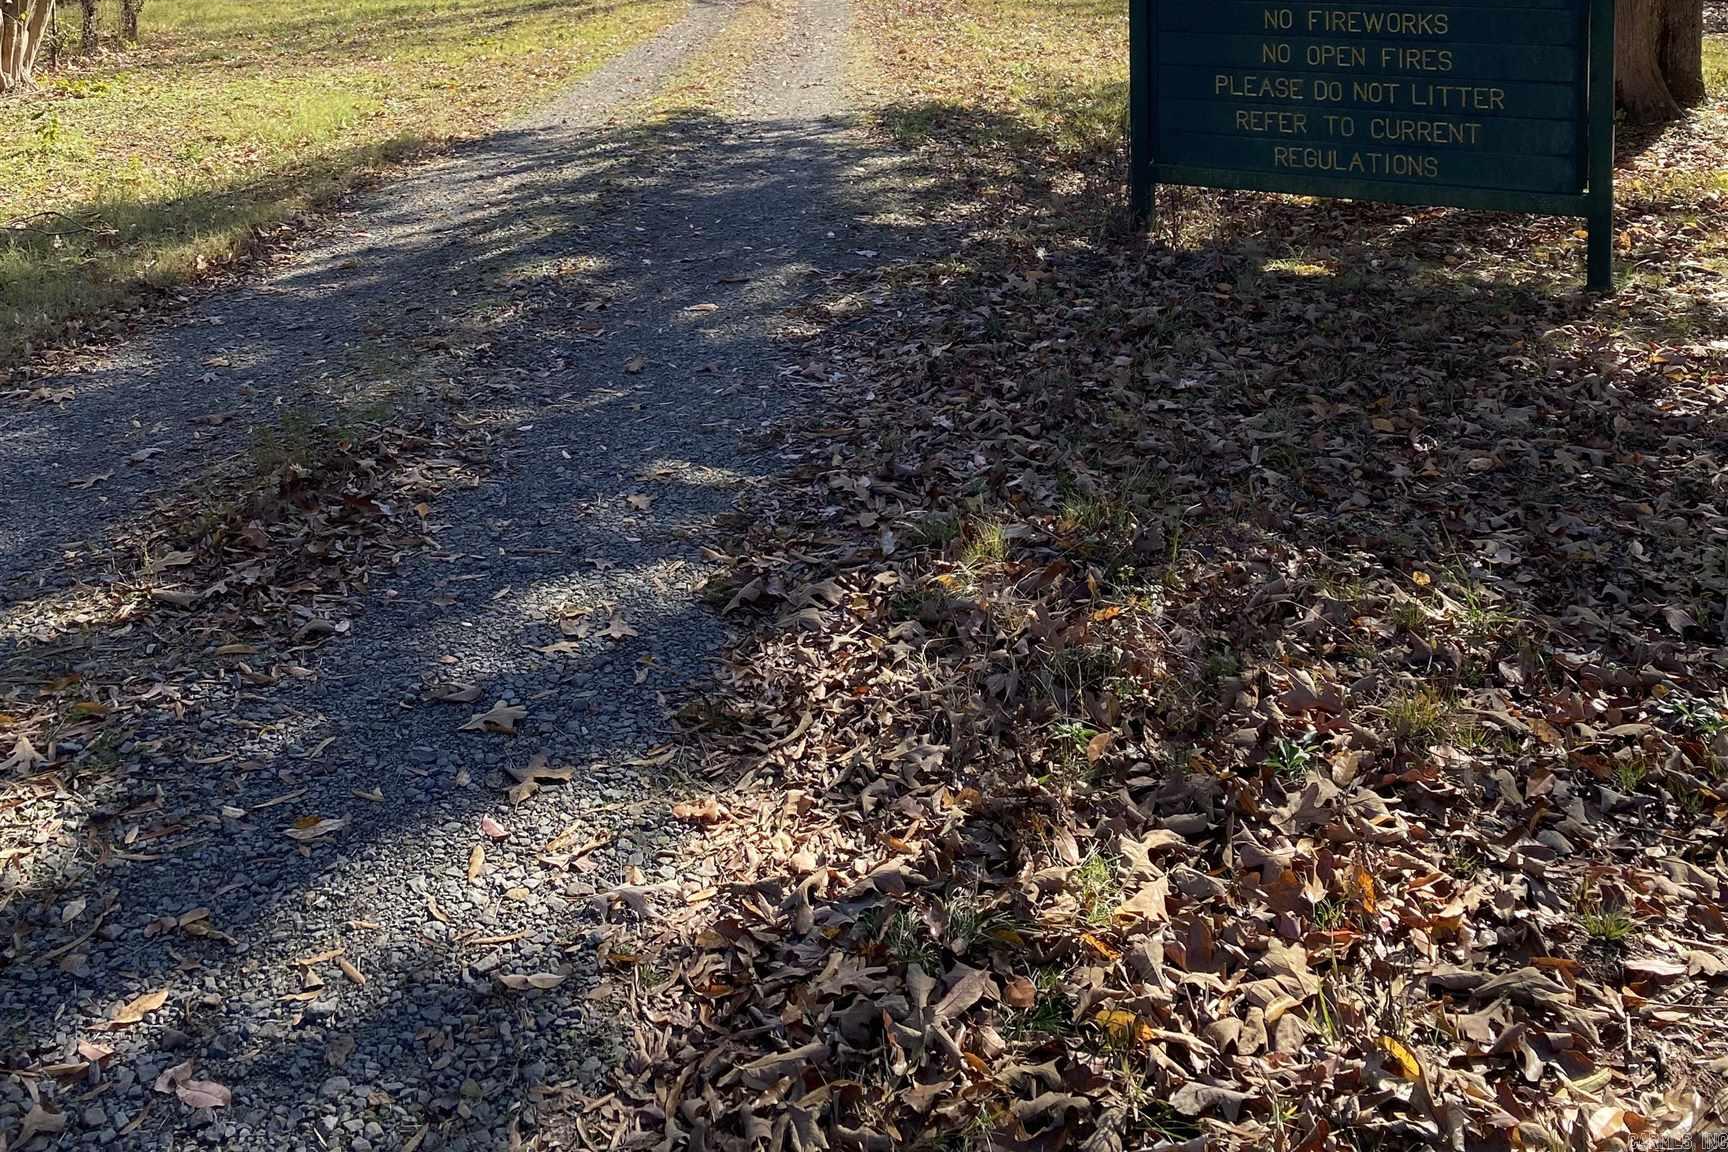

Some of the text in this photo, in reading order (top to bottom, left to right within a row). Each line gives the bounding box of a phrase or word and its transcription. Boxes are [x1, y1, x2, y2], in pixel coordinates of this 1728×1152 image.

[1264, 10, 1448, 34] NO FIREWORKS
[1263, 43, 1452, 71] NO OPEN FIRES
[1216, 76, 1504, 110] PLEASE DO NOT LITTER
[1236, 111, 1481, 144] REFER TO CURRENT
[1275, 147, 1438, 177] REGULATIONS
